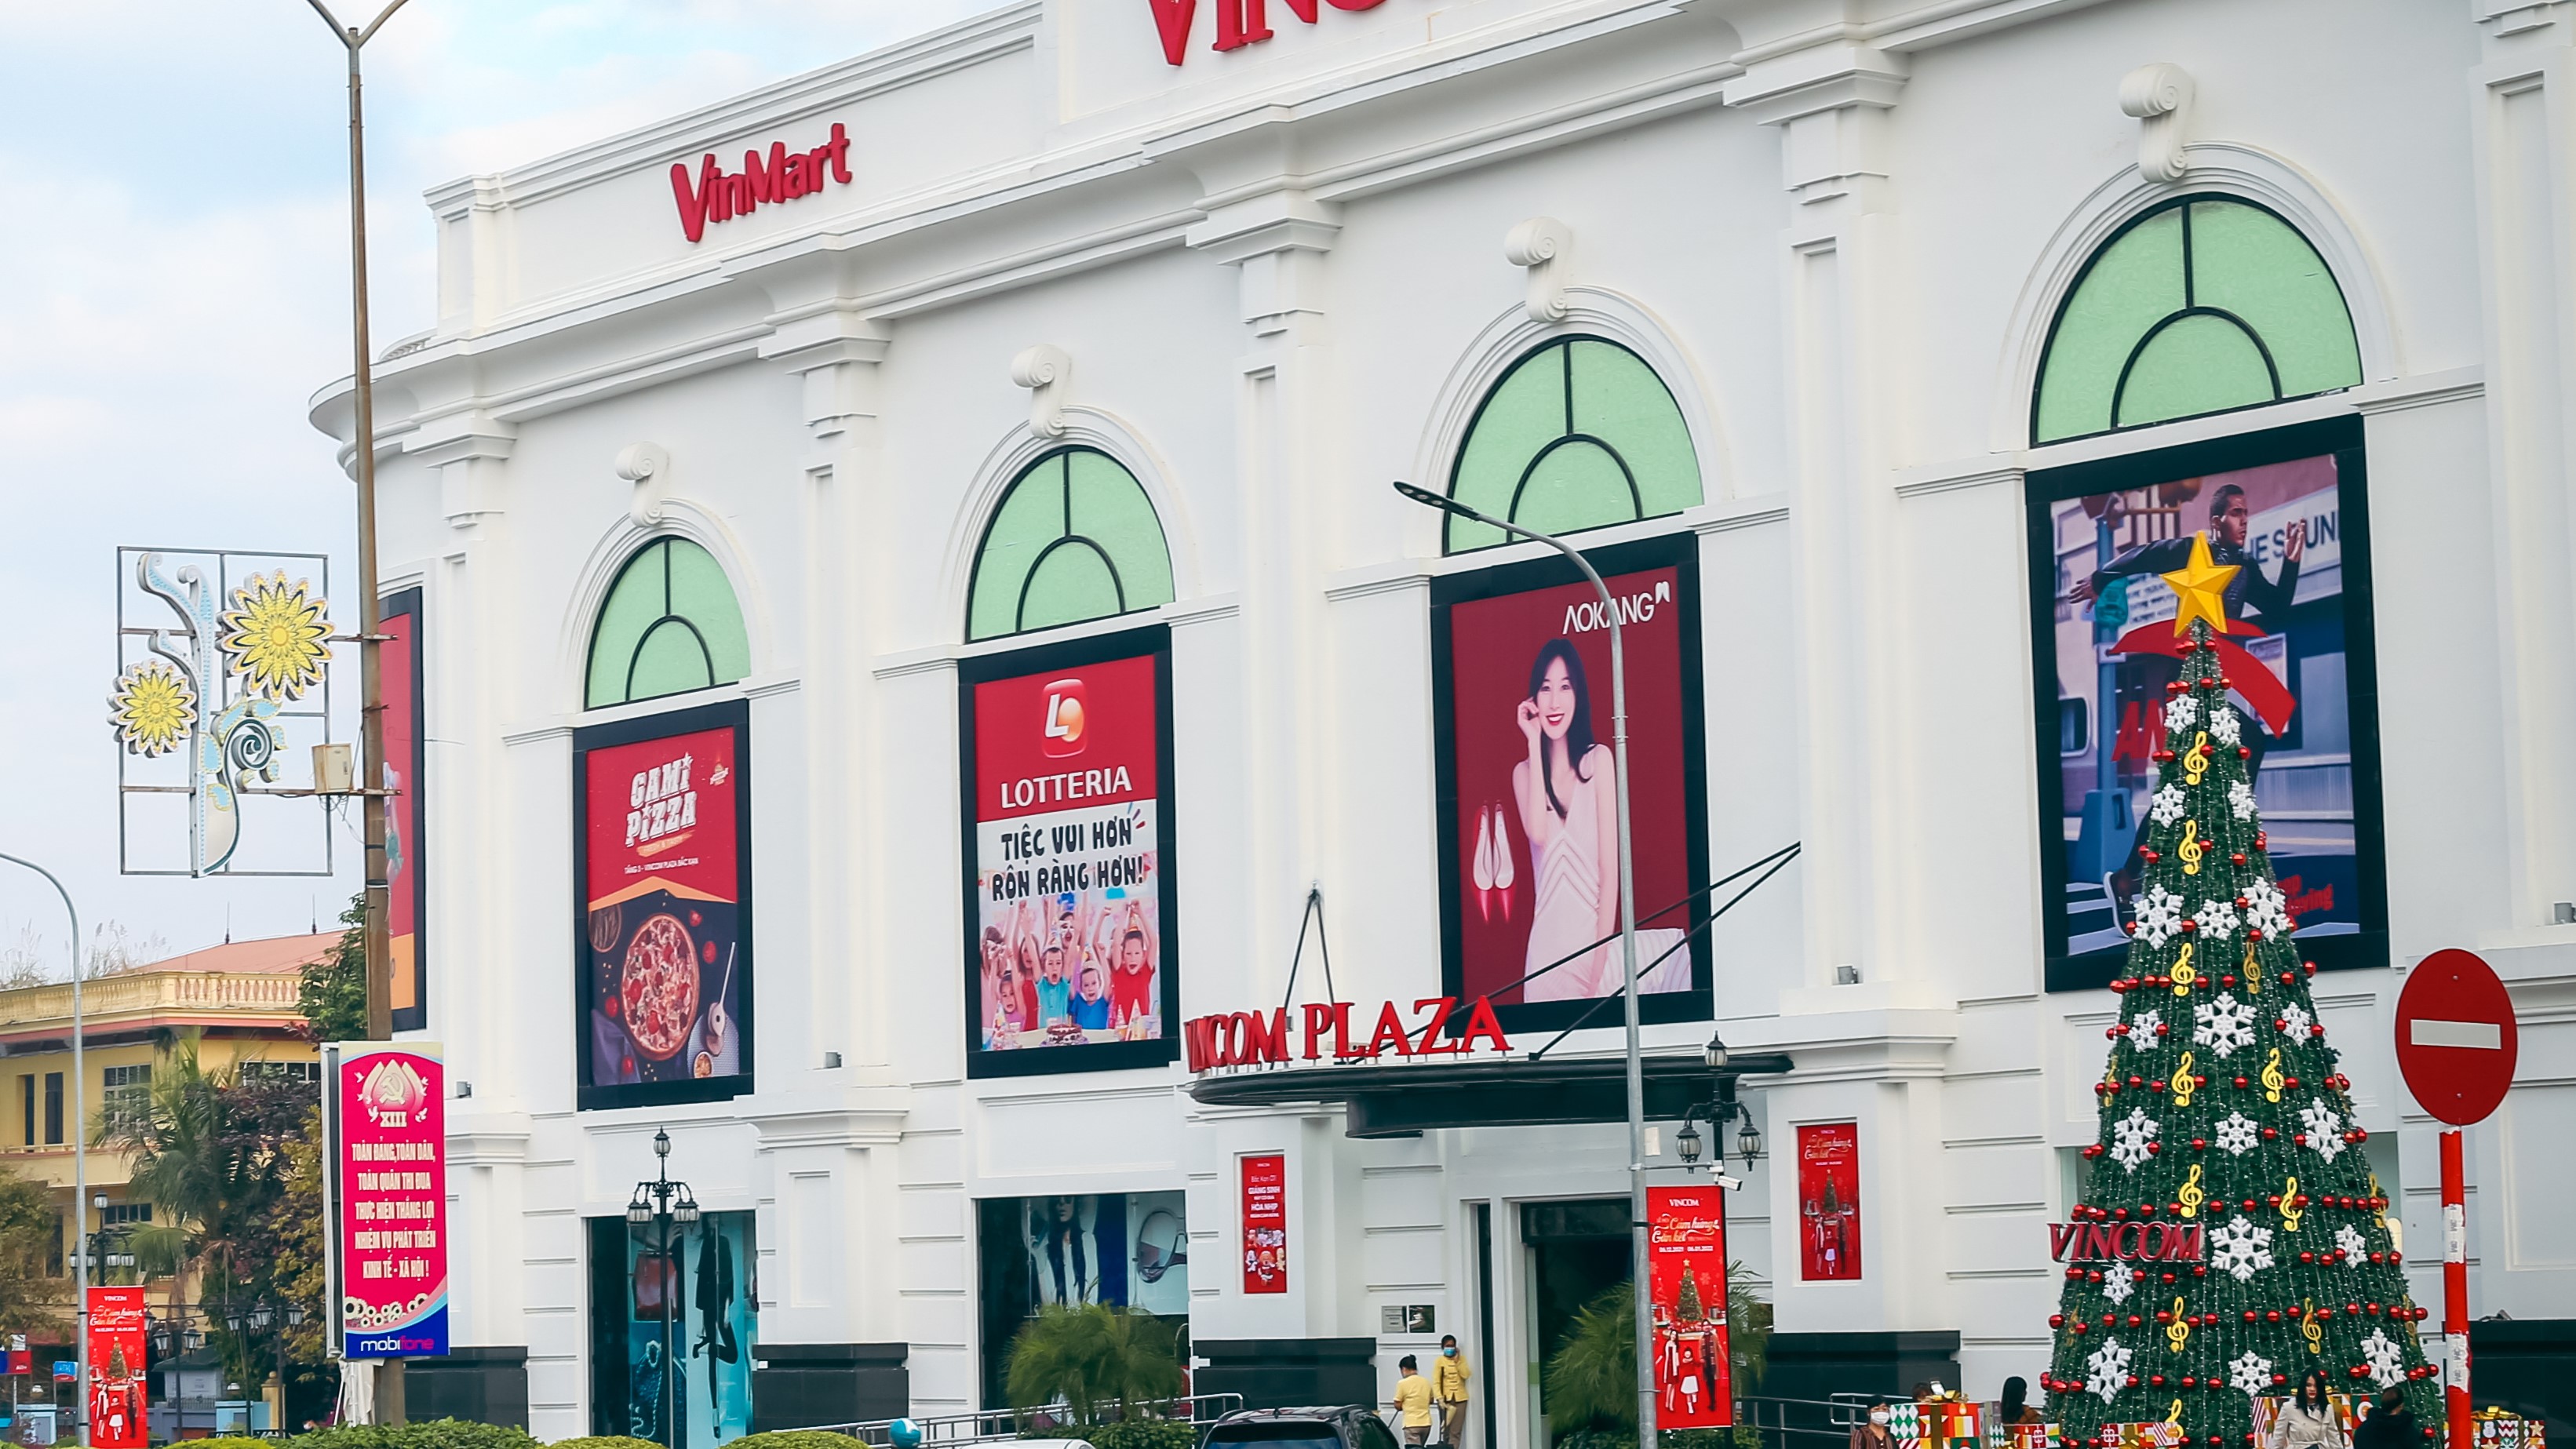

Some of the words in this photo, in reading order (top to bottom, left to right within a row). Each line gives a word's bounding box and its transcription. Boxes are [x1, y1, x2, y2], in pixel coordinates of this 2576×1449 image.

[670, 123, 852, 242] VinMart
[1000, 766, 1132, 809] LOTTERIA
[1000, 824, 1044, 865] TIỆC
[1052, 824, 1084, 854] VUI
[1092, 816, 1131, 850] HƠN
[992, 865, 1030, 905] RỘN
[1037, 858, 1089, 895] RÀNG
[1097, 854, 1143, 889] HƠN!
[1301, 994, 1514, 1060] PLAZA
[380, 1112, 407, 1127] XIII
[352, 1140, 373, 1161] TOÀN
[358, 1169, 378, 1191] TOÀN
[402, 1172, 414, 1190] THI
[415, 1172, 432, 1190] ĐUA
[355, 1201, 374, 1223] THỰC
[377, 1198, 395, 1223] HIỆN
[396, 1196, 421, 1219] THẮNG
[355, 1227, 381, 1254] NHIỆM
[381, 1230, 392, 1254] VỤ
[393, 1227, 414, 1248] PHÁT
[2046, 1221, 2206, 1263] VINCOM
[363, 1261, 382, 1279] KINH
[383, 1254, 392, 1279] TẾ
[399, 1256, 410, 1278] XÃ
[360, 1335, 434, 1352] mobifone
